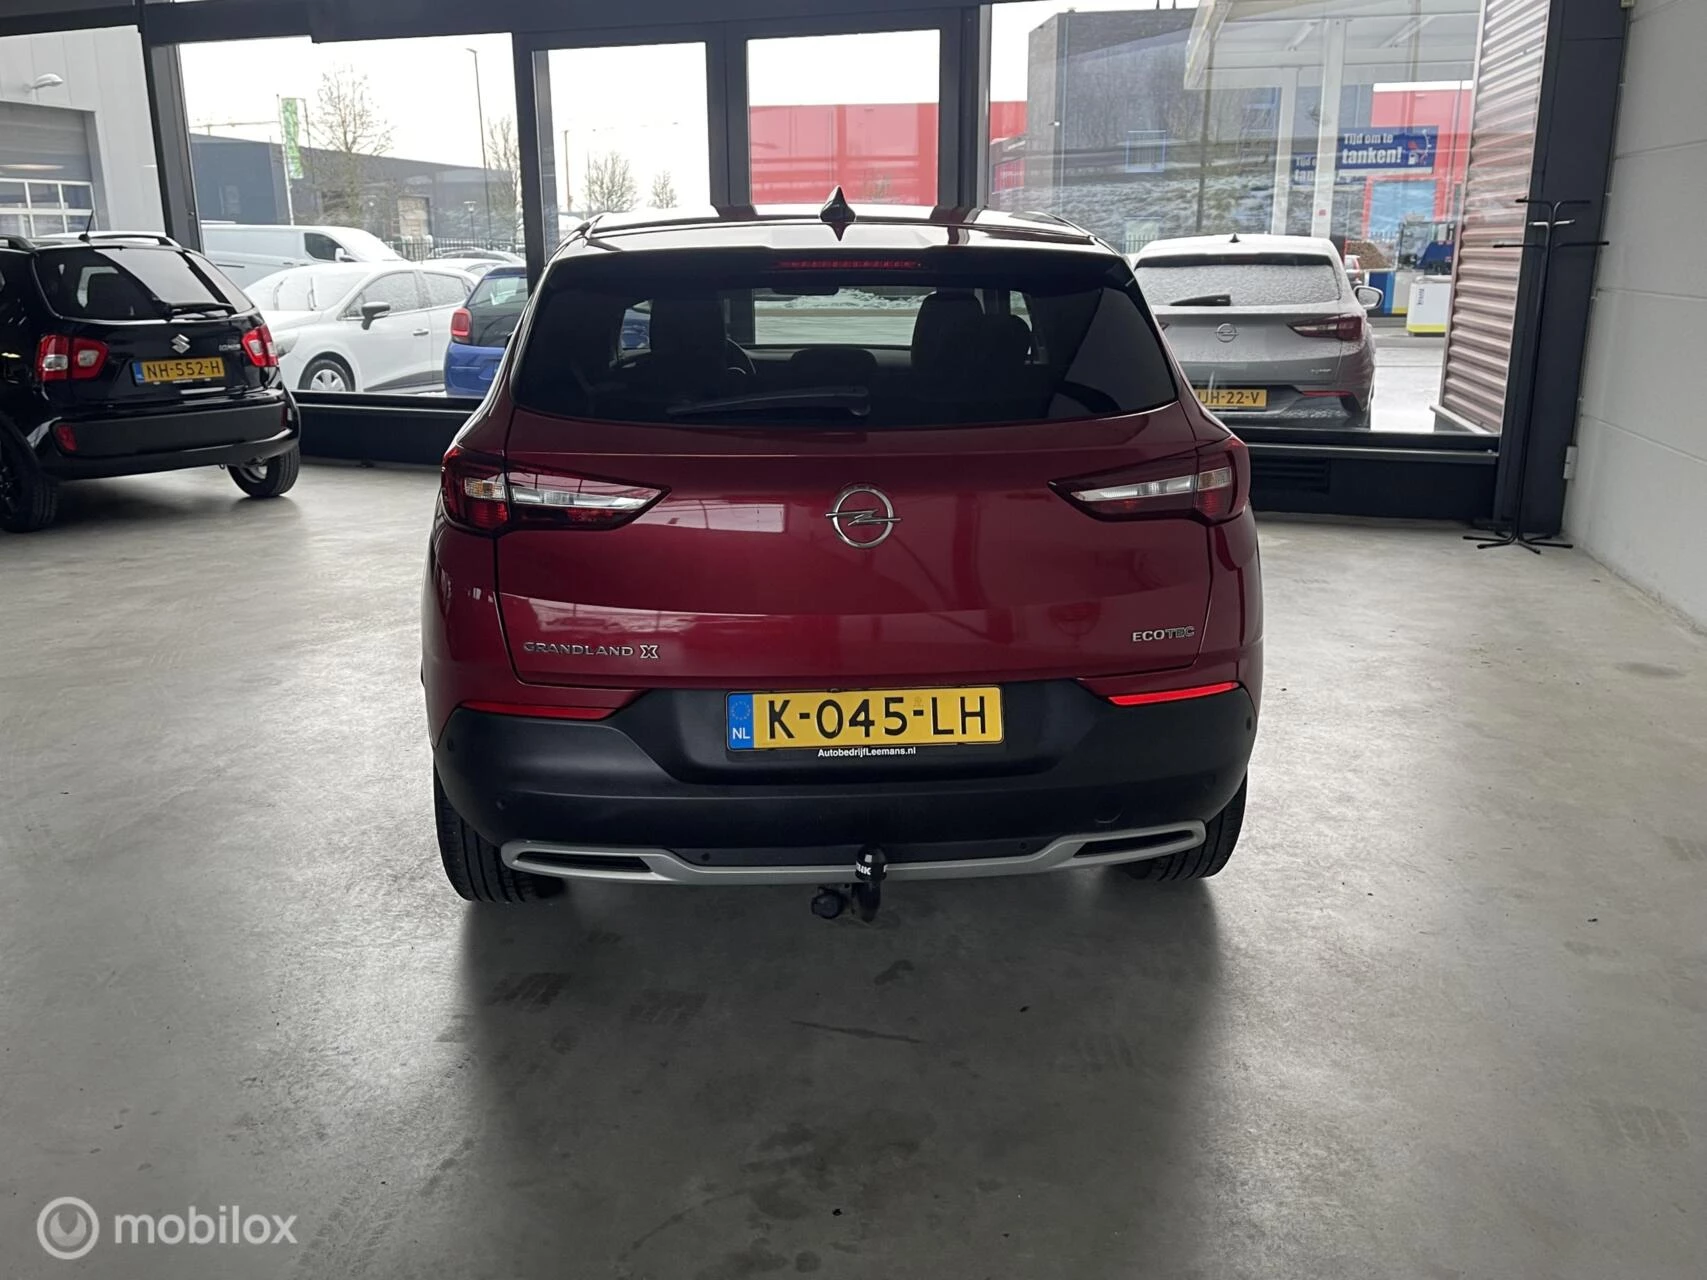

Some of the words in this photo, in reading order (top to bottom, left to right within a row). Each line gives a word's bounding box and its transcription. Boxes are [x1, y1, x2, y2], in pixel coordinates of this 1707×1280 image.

[1343, 132, 1363, 145] Tijd
[1364, 134, 1382, 144] om
[1383, 132, 1394, 144] te
[1342, 146, 1402, 164] tanken!
[146, 360, 221, 379] NH-552-H
[1132, 626, 1195, 642] ECOTEC
[523, 642, 634, 656] GRANDLAND
[639, 644, 659, 659] X
[767, 695, 987, 741] K-045-LH
[732, 728, 751, 740] NL
[817, 747, 917, 758] AutobedrijfLeemans.nl
